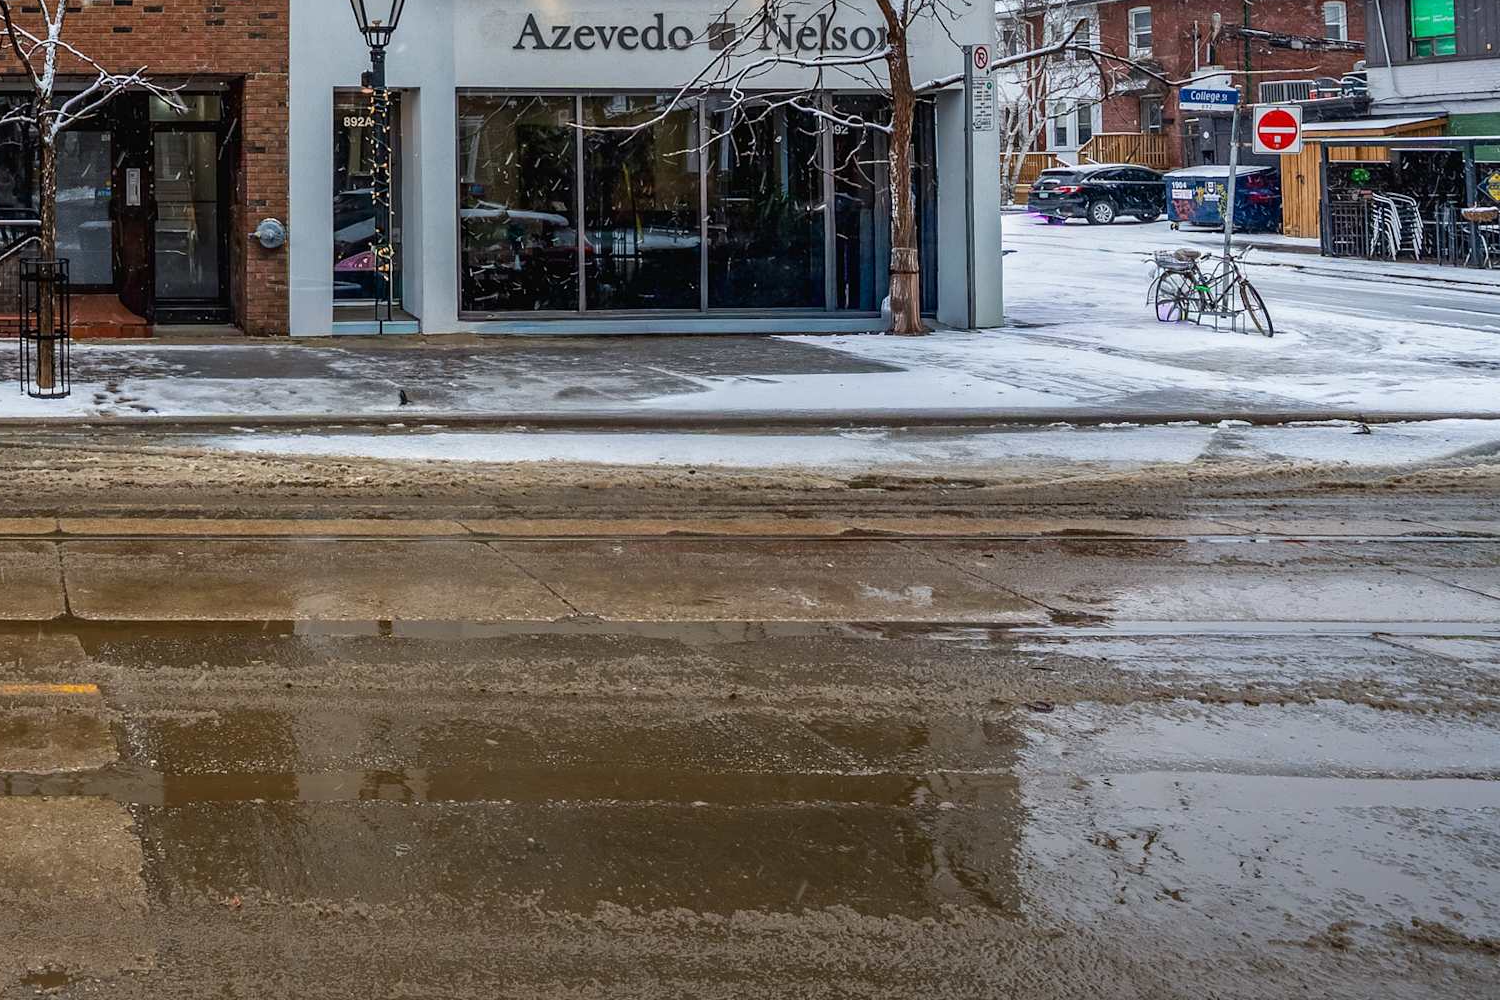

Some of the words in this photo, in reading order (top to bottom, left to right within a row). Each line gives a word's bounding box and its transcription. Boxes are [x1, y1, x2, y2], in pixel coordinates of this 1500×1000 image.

[513, 13, 693, 50] Azevedo
[1190, 90, 1220, 103] College
[343, 116, 374, 127] 892A
[831, 123, 849, 135] 92
